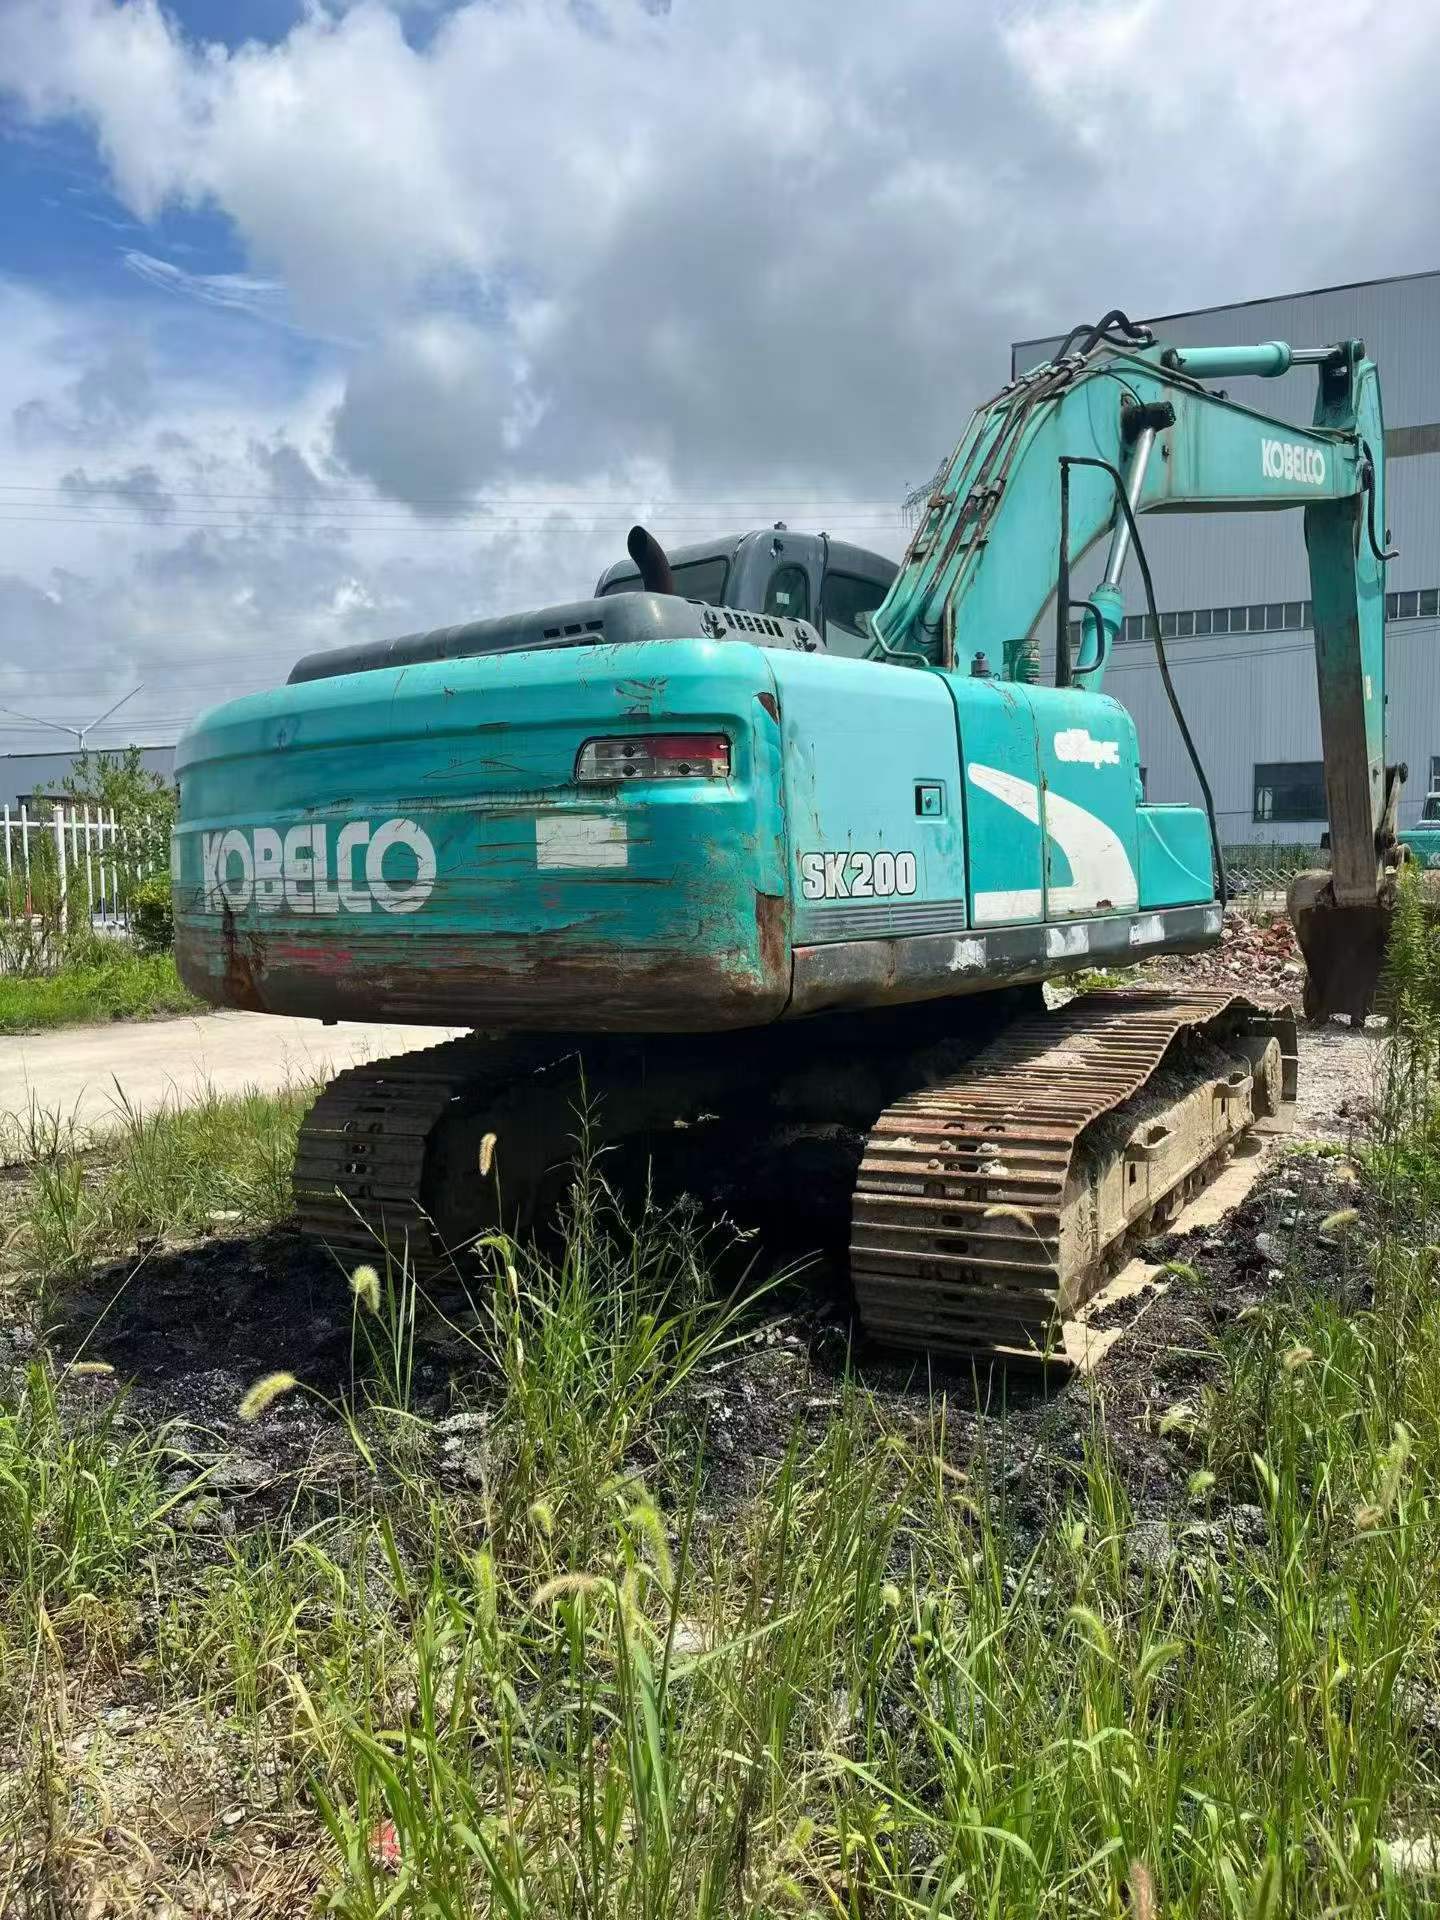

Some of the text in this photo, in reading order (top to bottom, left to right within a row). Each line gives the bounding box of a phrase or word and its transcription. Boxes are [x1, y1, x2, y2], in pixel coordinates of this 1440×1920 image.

[1261, 438, 1326, 485] KOBELCO
[201, 818, 437, 914] KOBELCO
[802, 851, 917, 900] SK200
